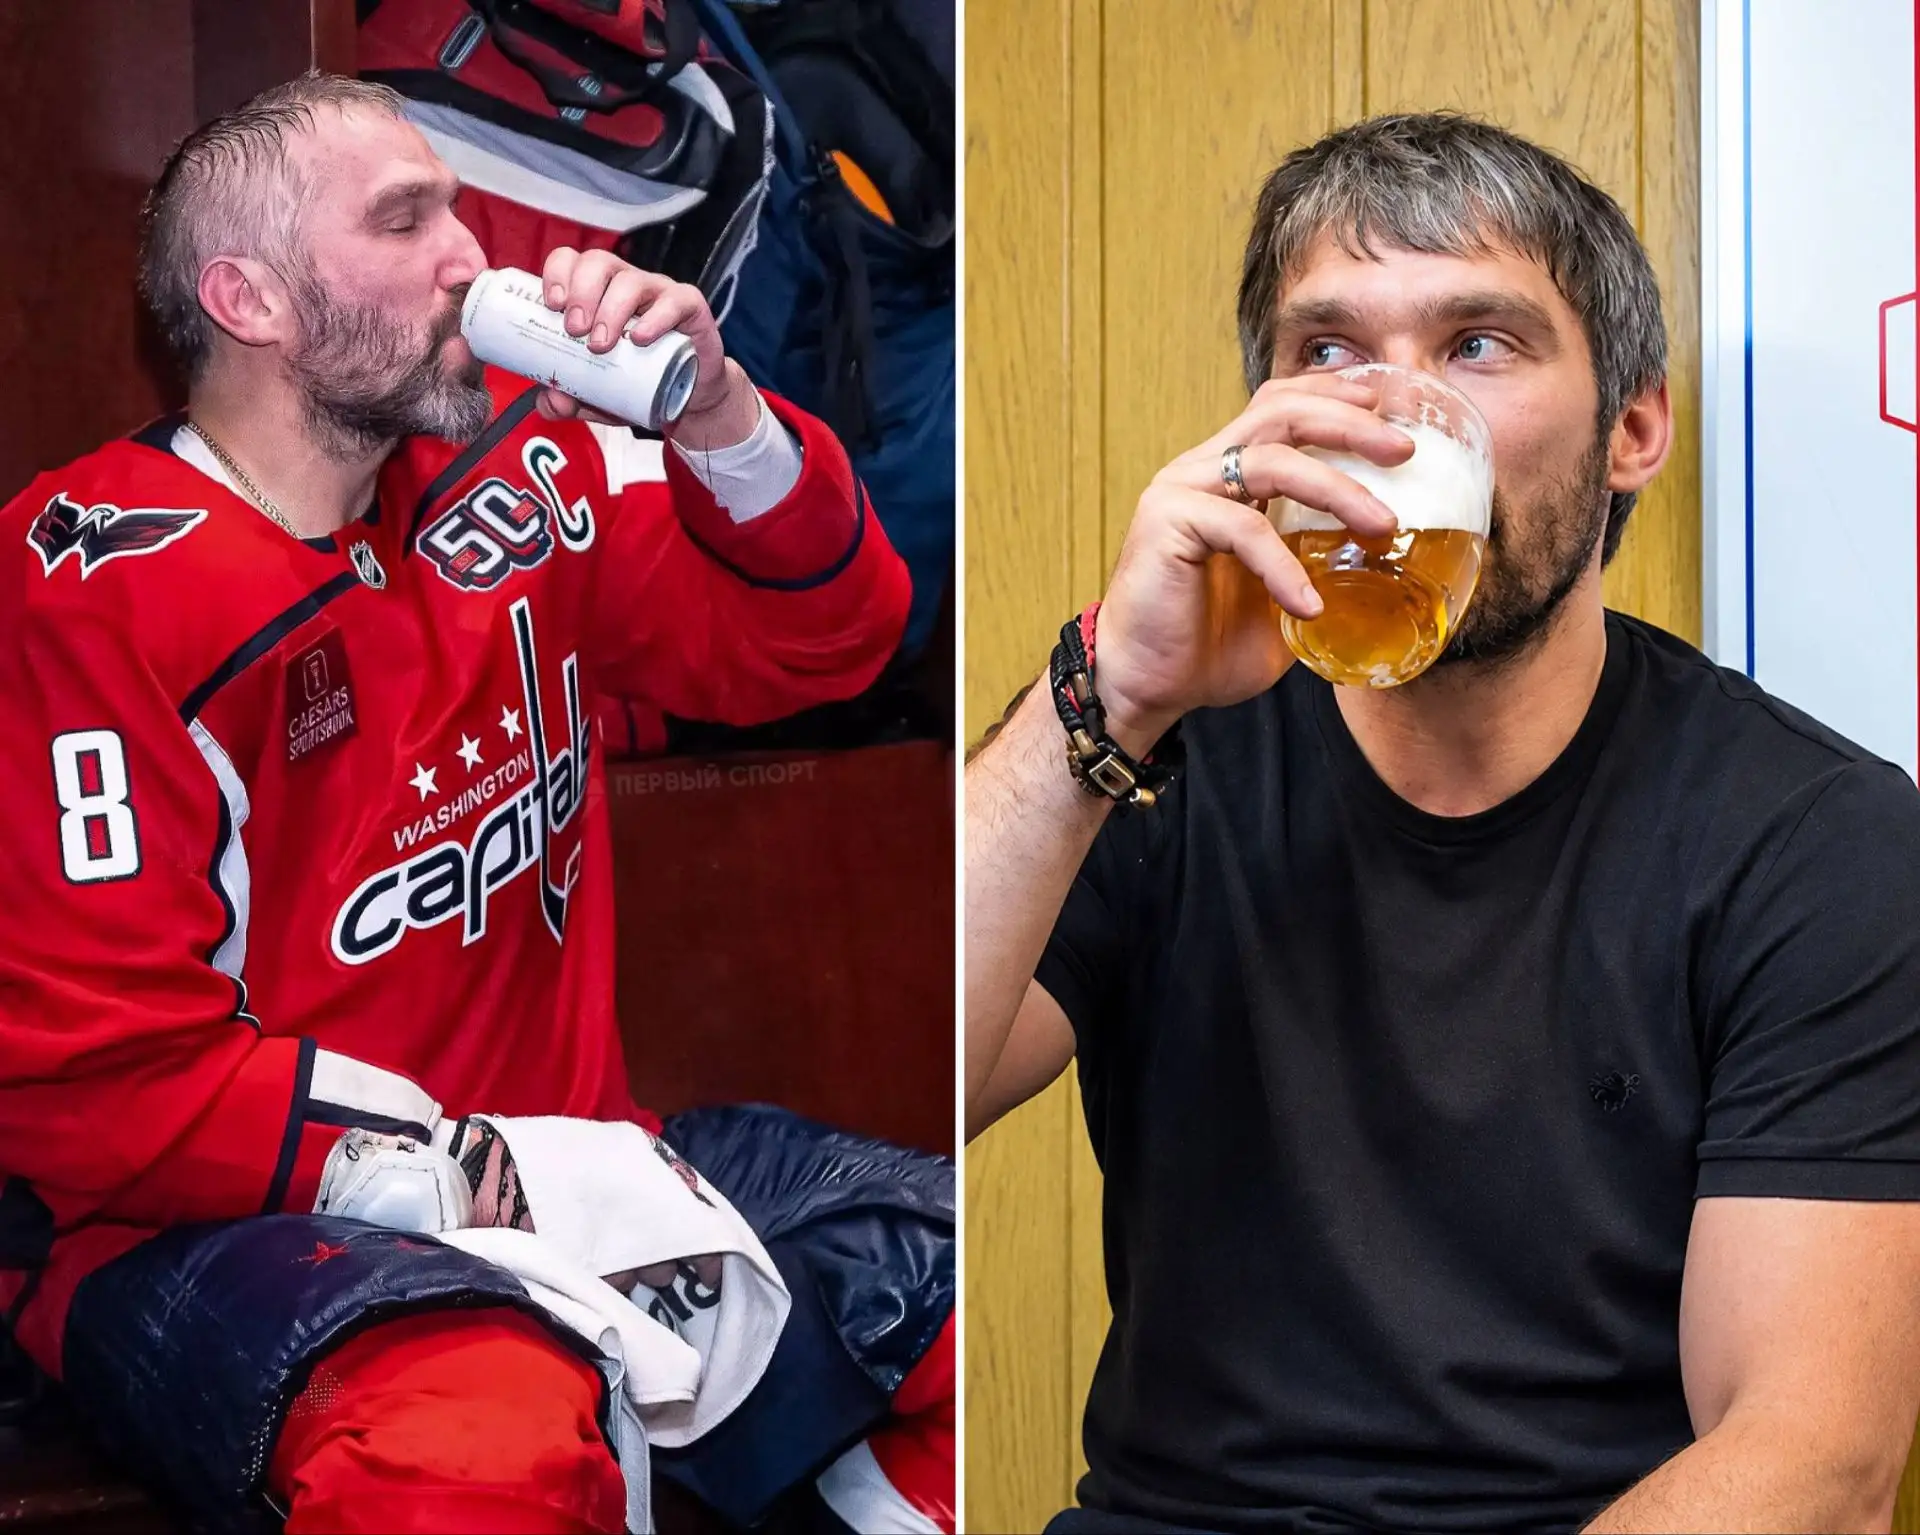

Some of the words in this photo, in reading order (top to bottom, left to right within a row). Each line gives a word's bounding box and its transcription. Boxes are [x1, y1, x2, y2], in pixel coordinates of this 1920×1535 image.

[419, 479, 548, 586] 50
[521, 433, 597, 553] C
[288, 686, 349, 738] CAESARS
[289, 706, 355, 760] SPORTSBOOK
[50, 727, 144, 886] 8
[392, 749, 530, 852] WASHINGTON
